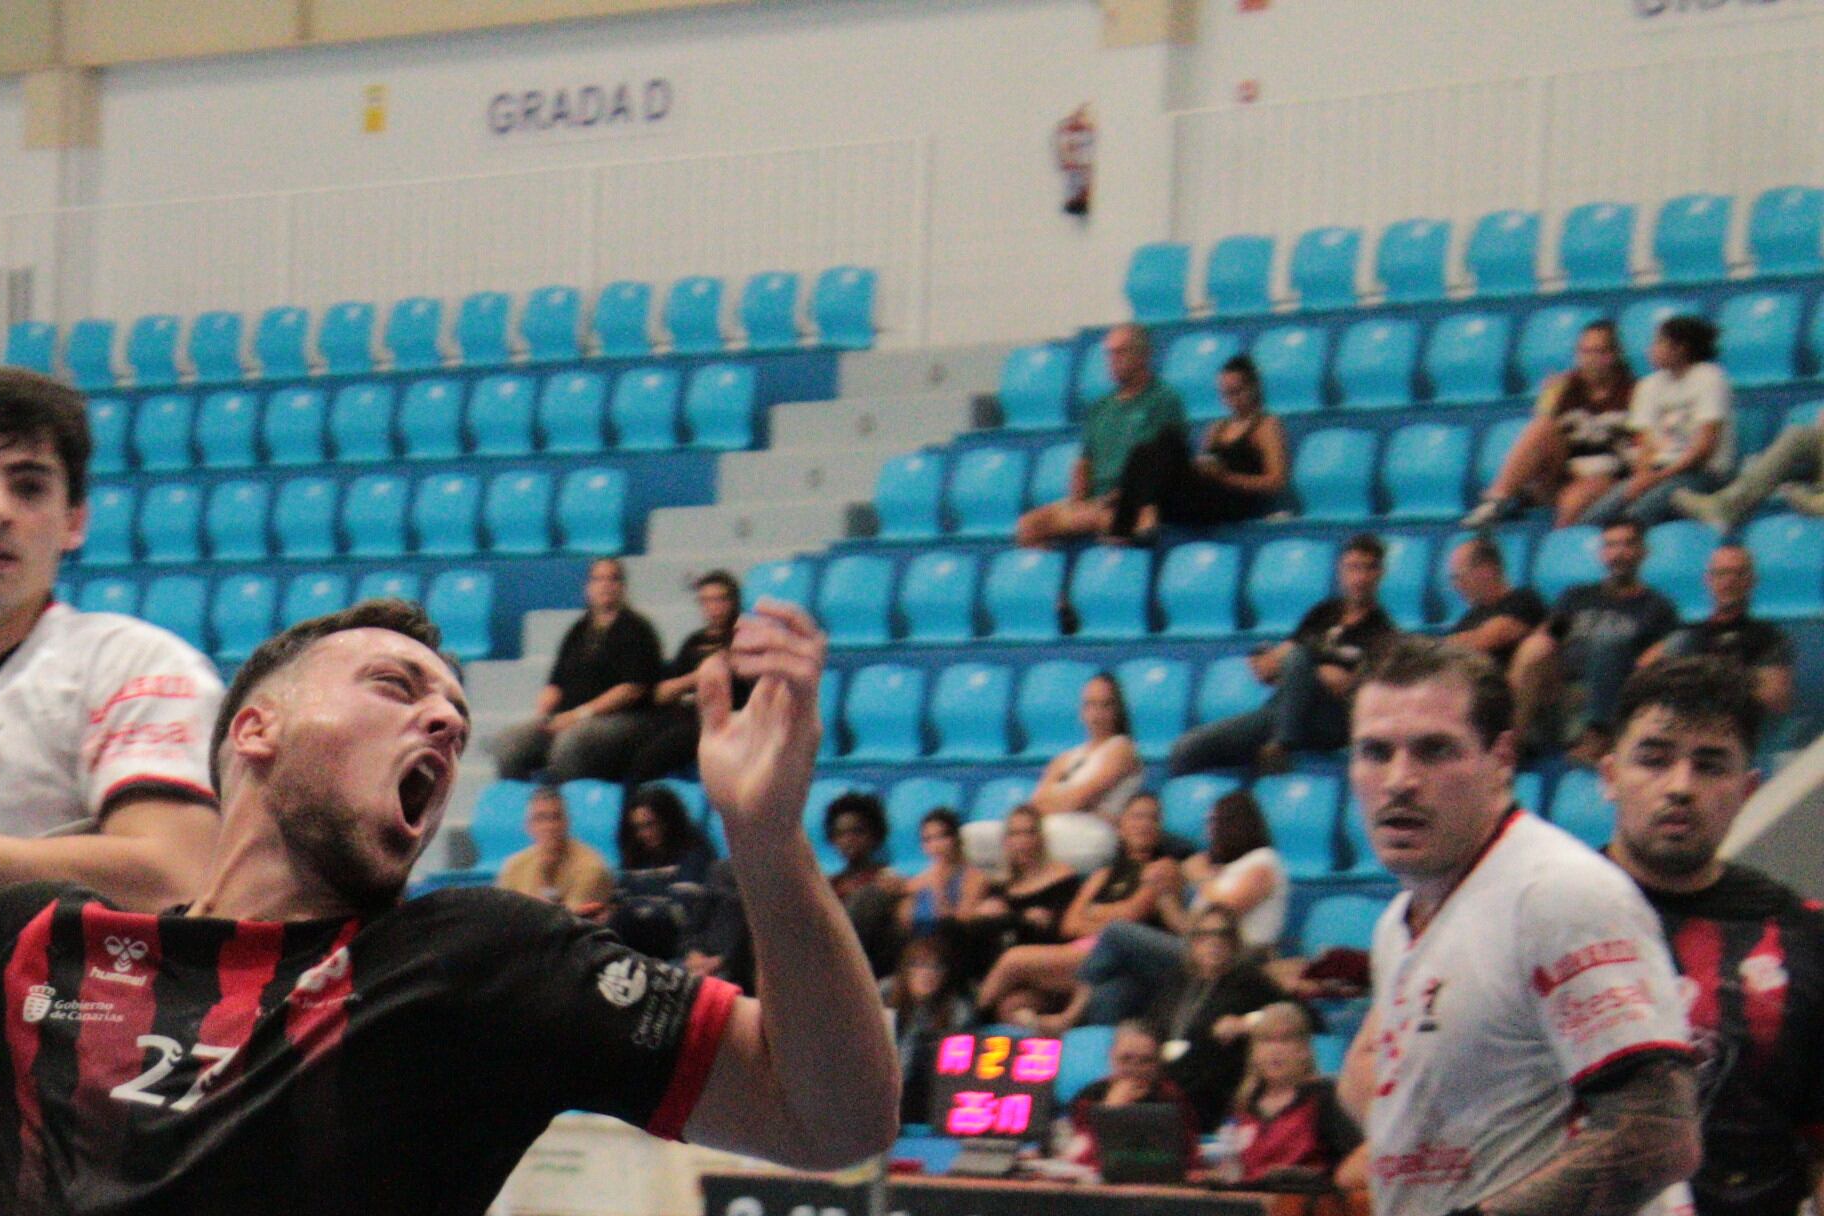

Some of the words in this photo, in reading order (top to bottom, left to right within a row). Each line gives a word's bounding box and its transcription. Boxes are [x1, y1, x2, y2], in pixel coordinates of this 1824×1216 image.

[488, 83, 632, 134] GRADA
[644, 78, 674, 121] D
[90, 966, 147, 986] hummel
[49, 1010, 67, 1020] de
[68, 1010, 125, 1022] Canarias
[53, 999, 114, 1011] Gobierno
[110, 1034, 241, 1112] 27
[976, 1036, 1011, 1079] 2
